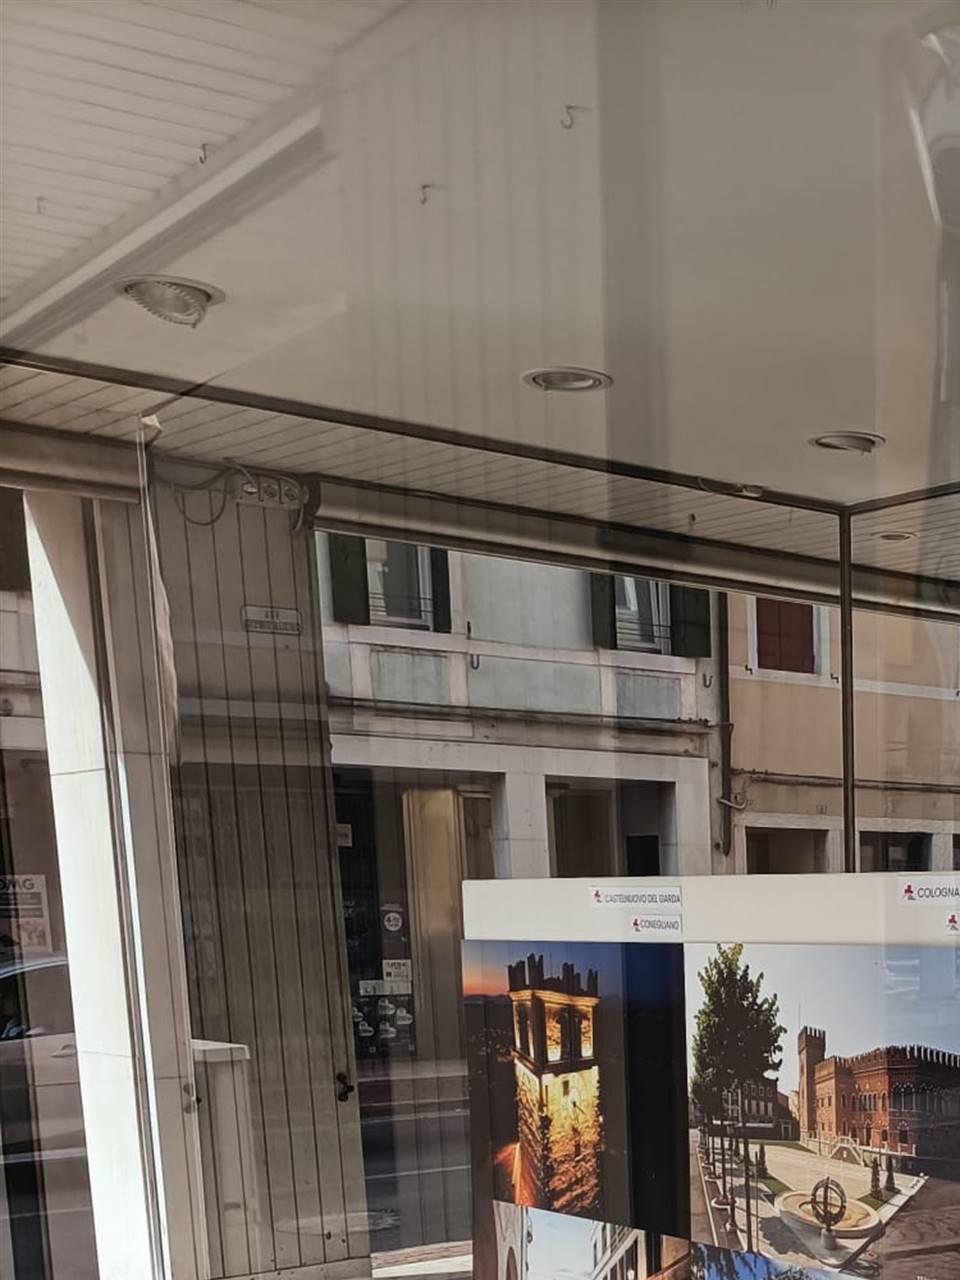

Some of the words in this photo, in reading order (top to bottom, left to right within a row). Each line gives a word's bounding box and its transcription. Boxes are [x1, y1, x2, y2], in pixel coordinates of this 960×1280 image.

[917, 886, 960, 898] COLOGNA
[604, 894, 647, 904] CASTELNUOVO
[648, 894, 657, 903] DEL
[659, 894, 680, 904] GARDA
[640, 919, 680, 930] CONEGLIANO
